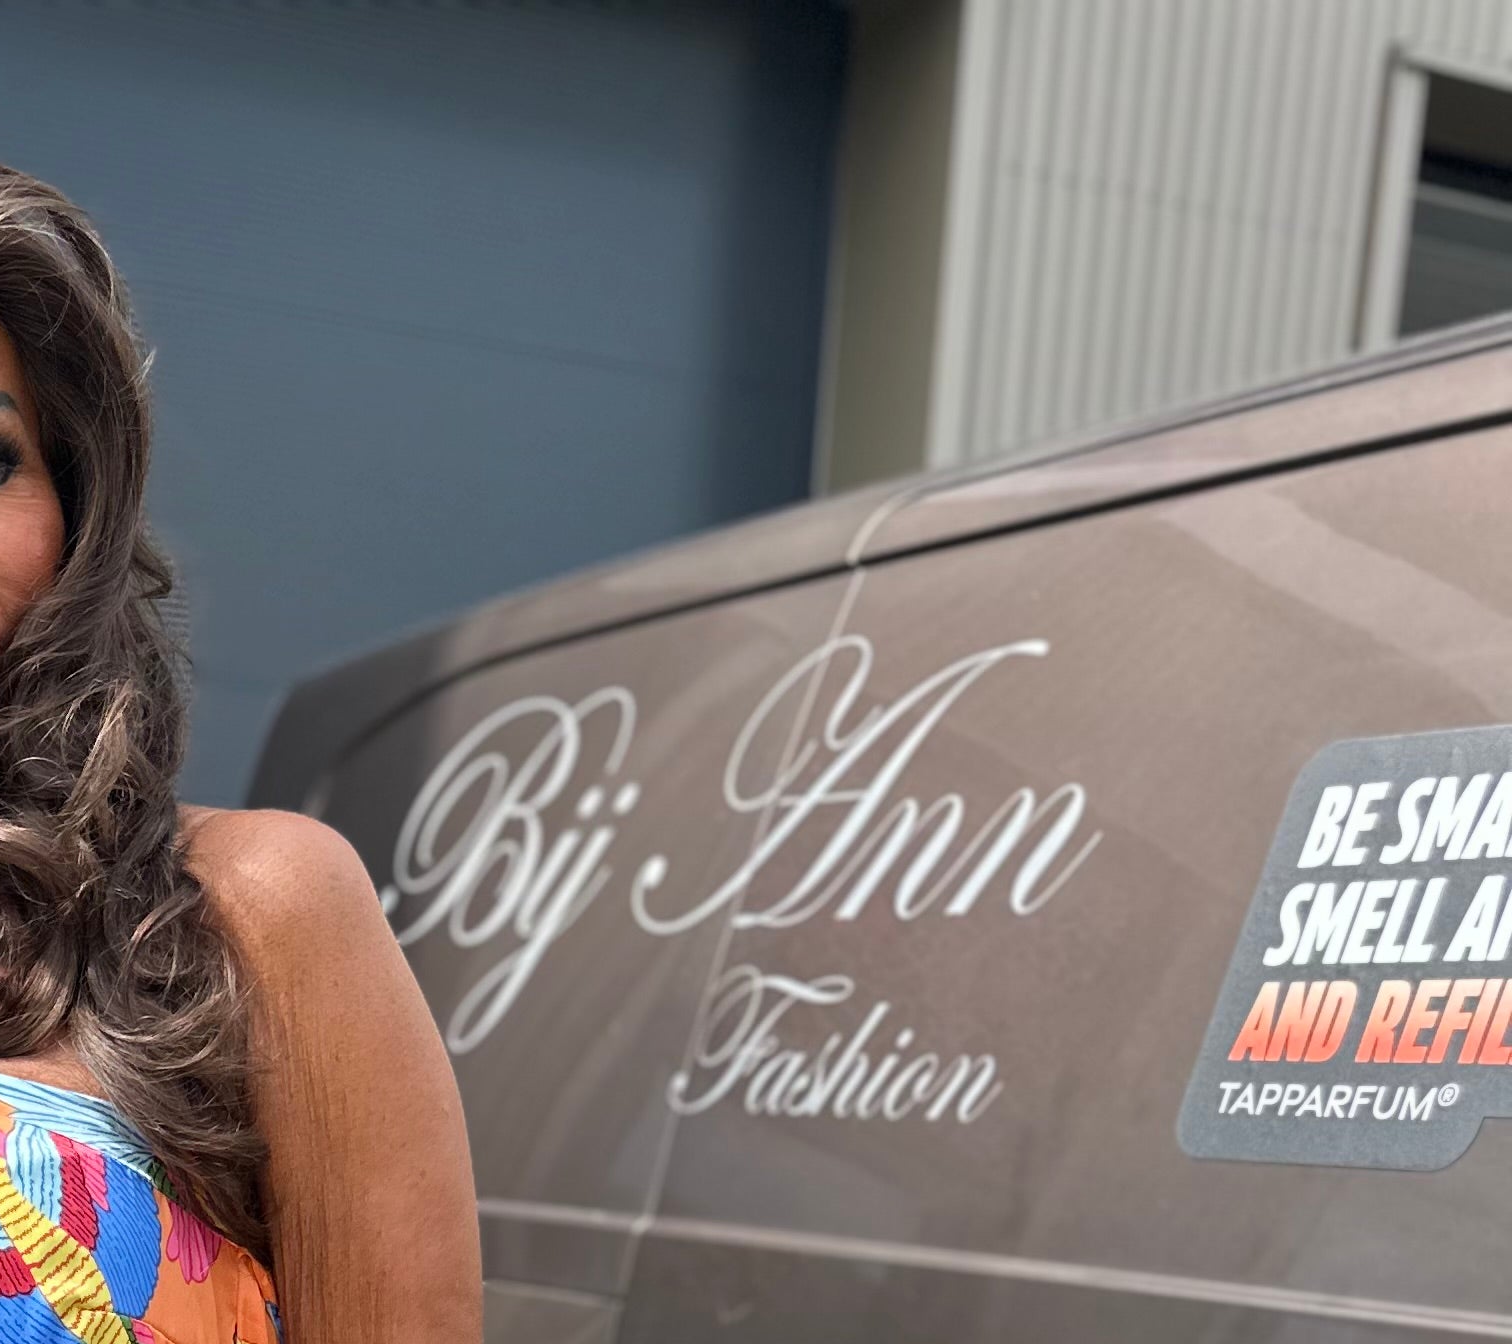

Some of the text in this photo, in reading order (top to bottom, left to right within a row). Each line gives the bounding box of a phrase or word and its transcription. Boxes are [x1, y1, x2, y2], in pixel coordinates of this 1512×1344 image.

[380, 634, 1102, 1056] Bij Ann
[1296, 771, 1512, 869] BE SMA
[1262, 876, 1448, 967] SMELL
[667, 964, 1004, 1124] Fashion
[1227, 976, 1512, 1066] AND REFIL
